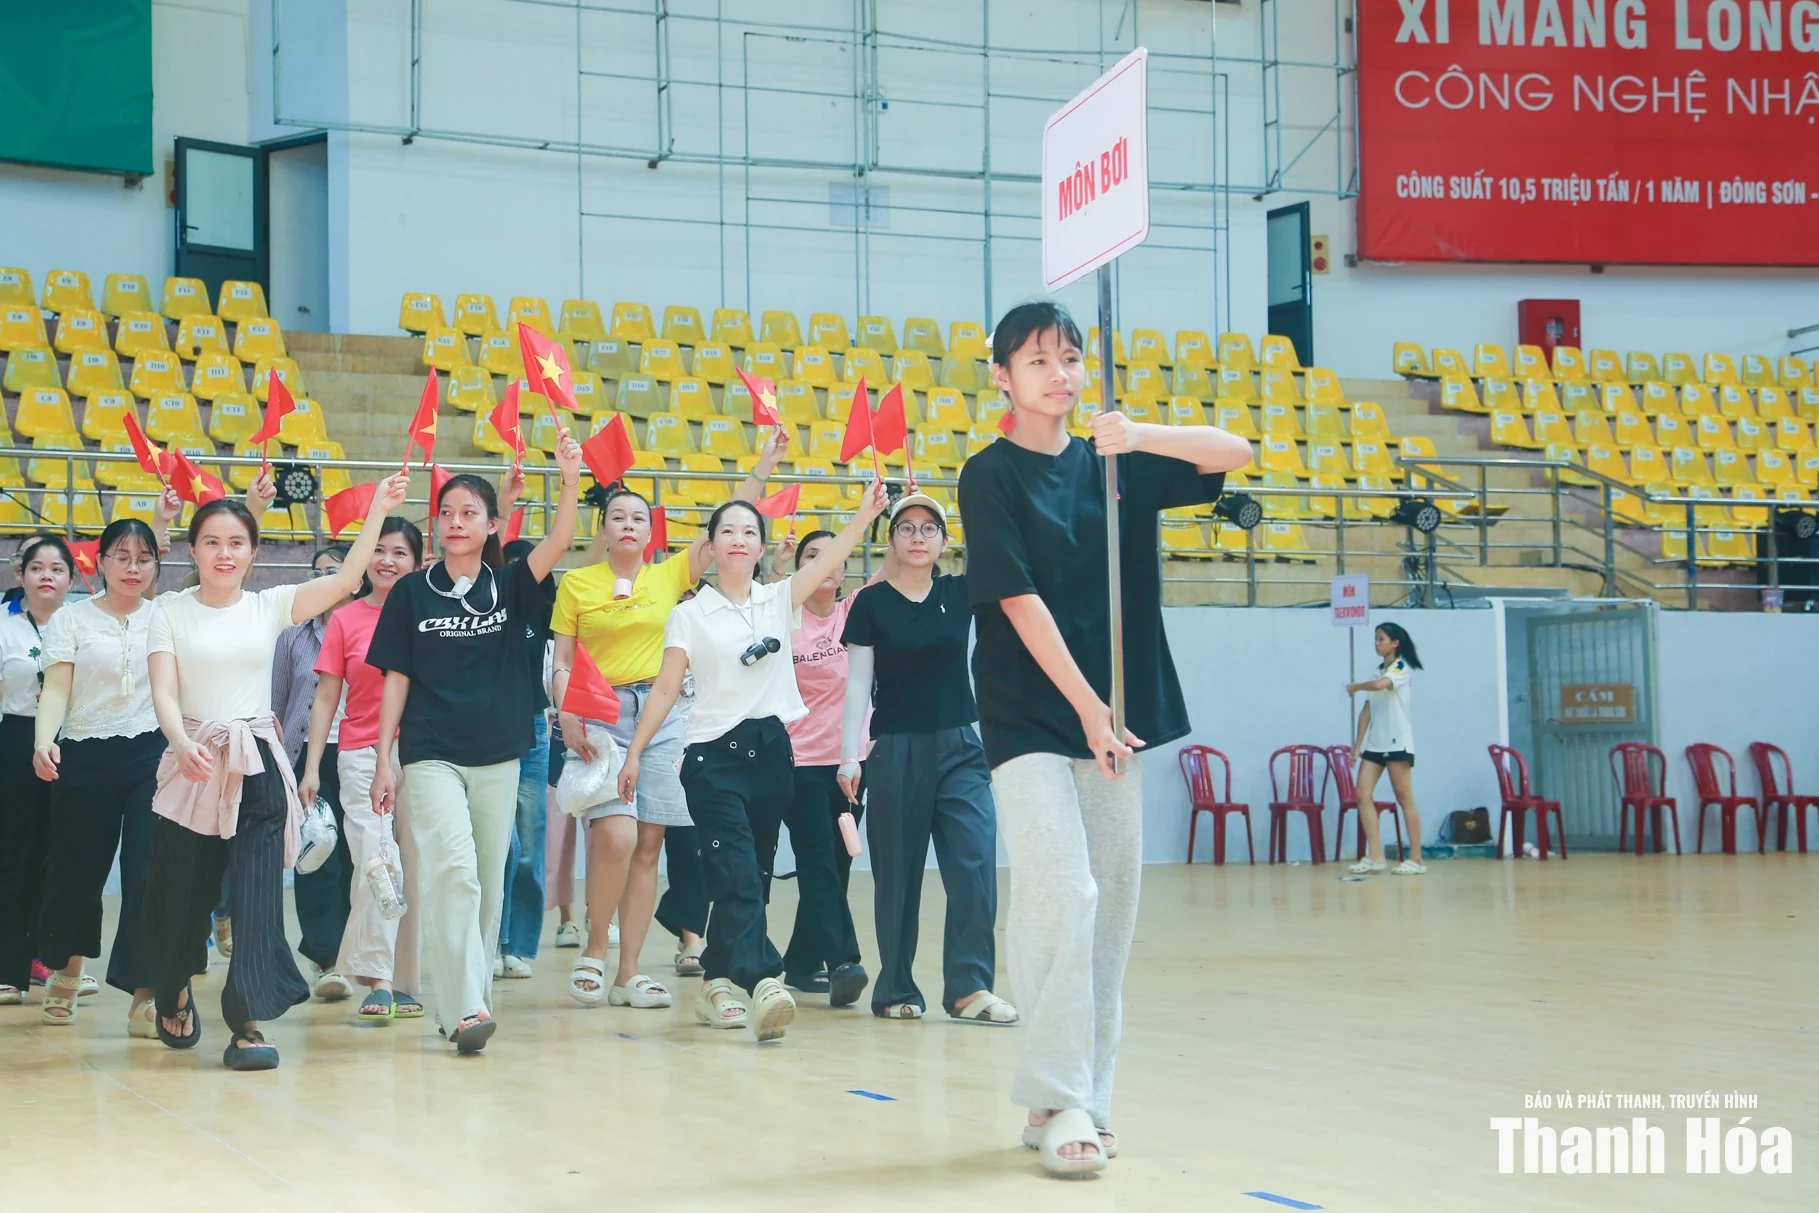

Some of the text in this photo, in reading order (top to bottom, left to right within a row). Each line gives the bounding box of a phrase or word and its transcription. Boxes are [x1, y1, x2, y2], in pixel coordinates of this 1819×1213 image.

[1395, 0, 1450, 44] XI
[1675, 0, 1819, 52] LONG
[1394, 64, 1554, 112] CÔNG
[1573, 69, 1708, 123] NGHỆ
[1059, 137, 1128, 222] MÔN BƠI
[1396, 170, 1445, 199] CÔNG
[1449, 169, 1495, 200] SUẤT
[1499, 177, 1537, 205] 10,5
[1541, 173, 1592, 207] TRIỆU
[1596, 171, 1631, 203] TẤN
[1645, 180, 1655, 203] 1
[1661, 177, 1701, 204] NĂM
[1719, 176, 1768, 205] ĐÔNG
[1772, 180, 1806, 205] SƠN
[439, 624, 502, 638] ORIGINAL BRAND
